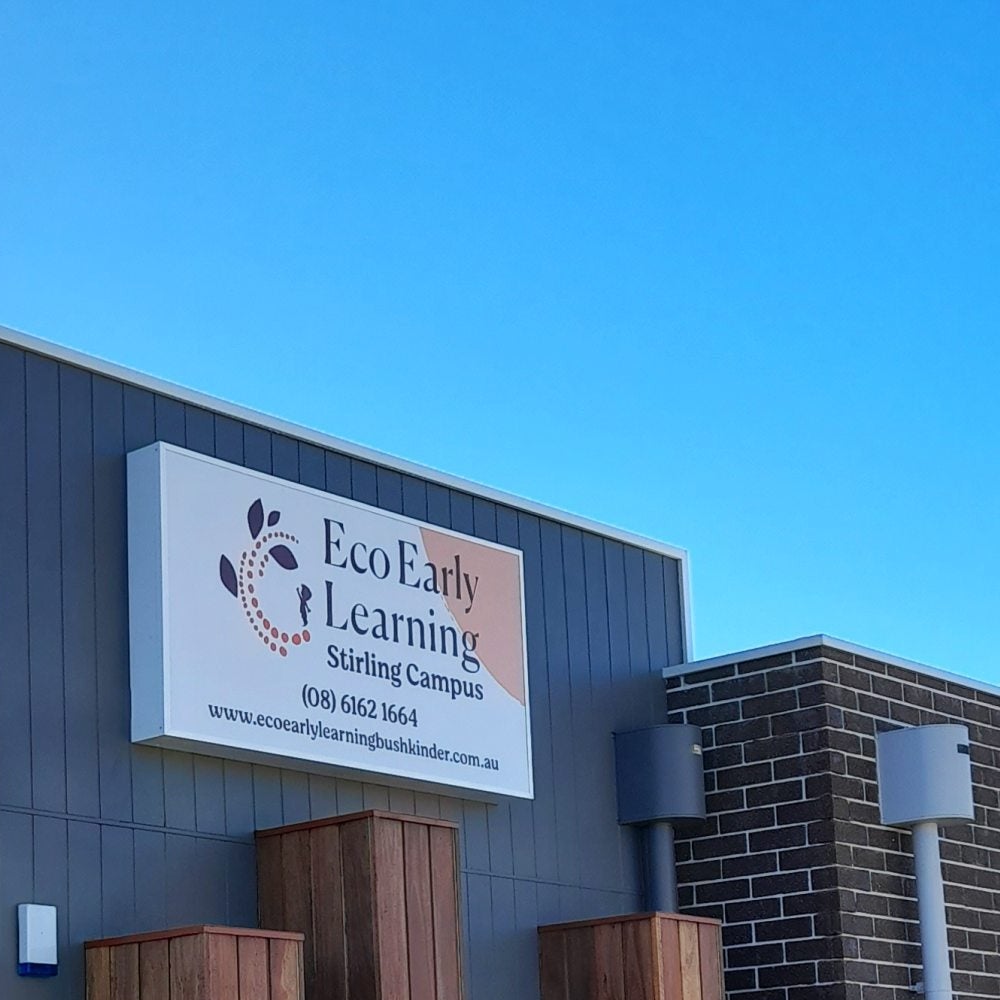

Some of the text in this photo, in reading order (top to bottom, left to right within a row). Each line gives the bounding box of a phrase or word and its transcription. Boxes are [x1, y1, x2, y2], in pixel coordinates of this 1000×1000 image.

[323, 517, 479, 614] Eco Early
[325, 580, 481, 673] Learning
[302, 684, 418, 727] (08) 6162 1664
[327, 644, 484, 701] Stirling Campus
[208, 704, 499, 771] www.ecoearlylearningbushkinder.com.au
